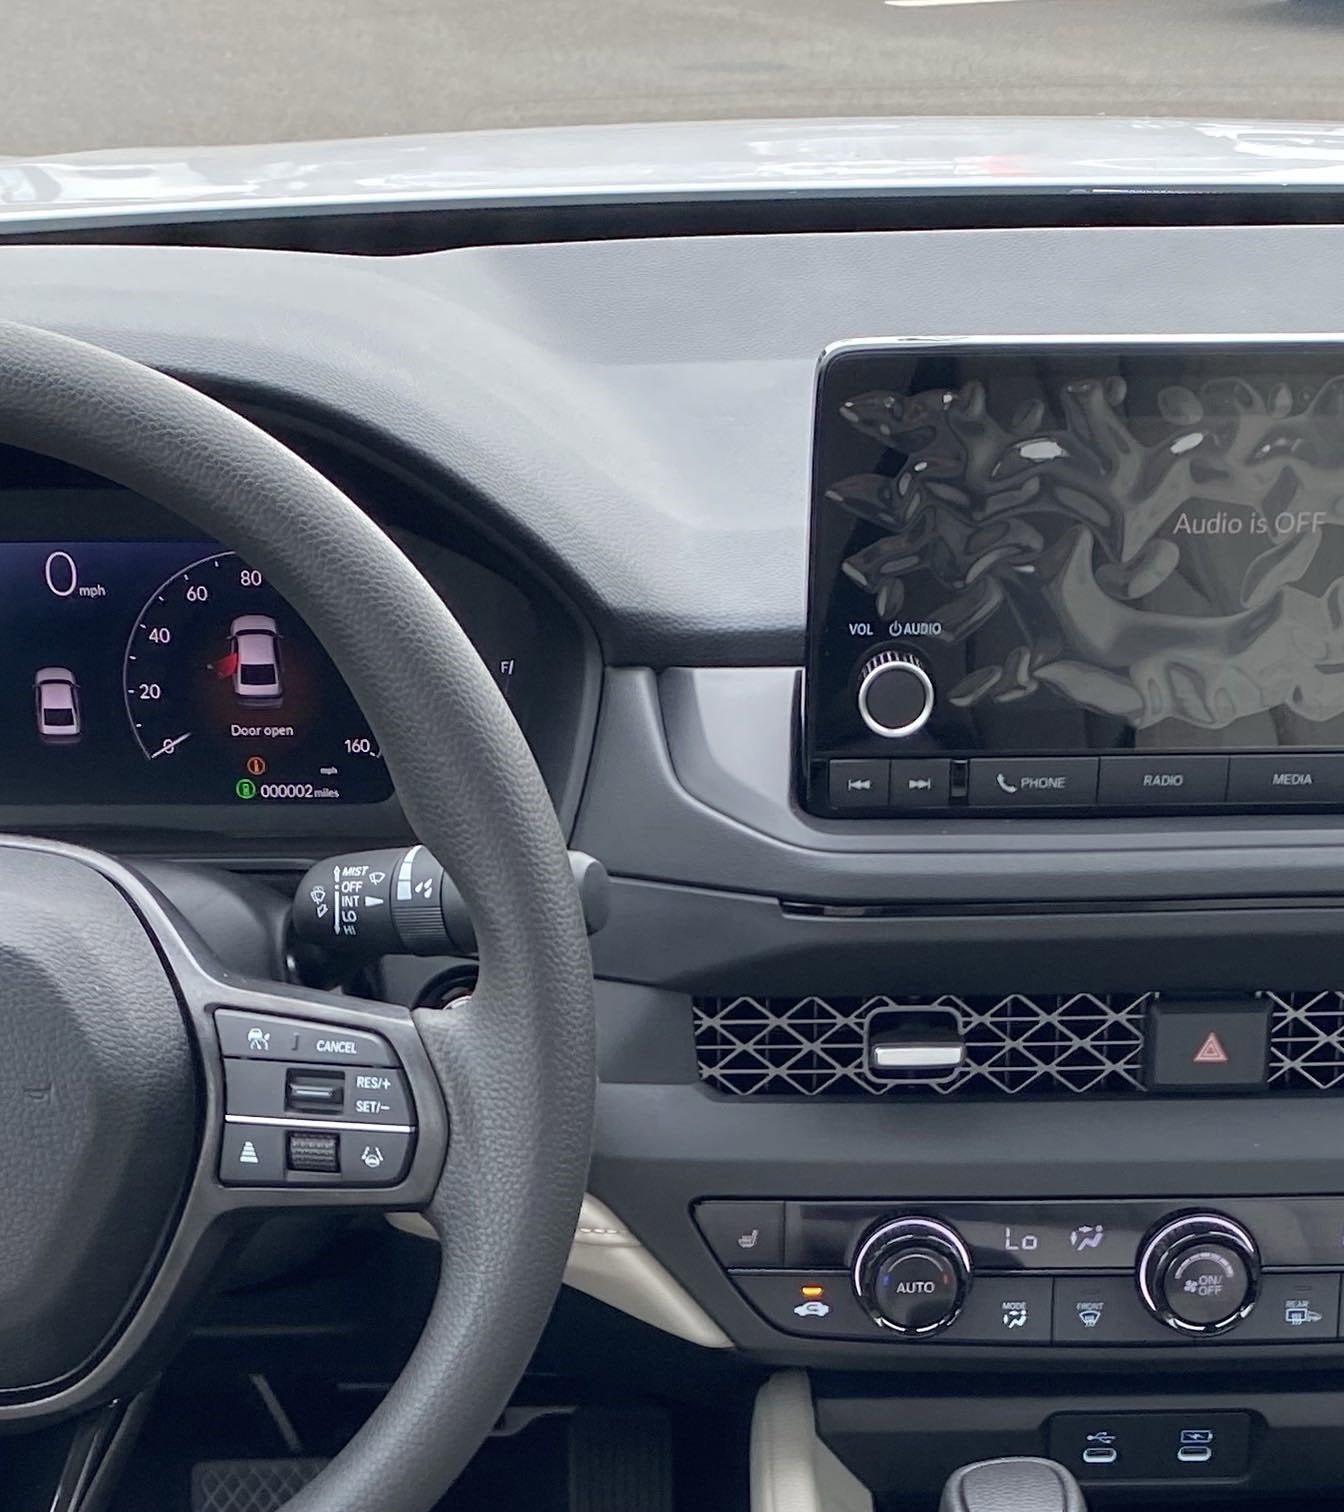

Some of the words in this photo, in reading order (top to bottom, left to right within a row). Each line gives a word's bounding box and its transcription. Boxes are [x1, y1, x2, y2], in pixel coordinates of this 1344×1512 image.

[1172, 511, 1244, 535] Audio
[1247, 511, 1268, 535] is
[1274, 510, 1328, 534] OFF
[44, 550, 78, 597] 0
[78, 585, 107, 600] mph
[239, 569, 263, 588] 80
[185, 585, 209, 603] 60
[147, 627, 171, 645] 40
[848, 622, 874, 637] VOL
[903, 621, 943, 636] AUDIO
[138, 683, 162, 701] 20
[230, 723, 261, 738] Door
[263, 726, 295, 740] open
[343, 738, 372, 754] 160
[1019, 775, 1067, 790] PHONE
[1143, 773, 1184, 787] RADIO
[1271, 772, 1313, 786] MEDIA
[259, 783, 315, 799] 000002
[314, 787, 341, 799] miles
[341, 865, 369, 878] MIST
[340, 880, 364, 893] OFF
[340, 895, 361, 908] INT
[341, 910, 358, 924] LO
[342, 924, 357, 937] HI
[316, 1039, 358, 1055] CANCEL
[356, 1076, 392, 1091] RES/+
[1004, 1226, 1038, 1251] Lo
[1197, 1274, 1223, 1286] ON/
[895, 1280, 936, 1296] AUTO
[1197, 1285, 1223, 1297] OFF
[1001, 1301, 1027, 1311] MODE
